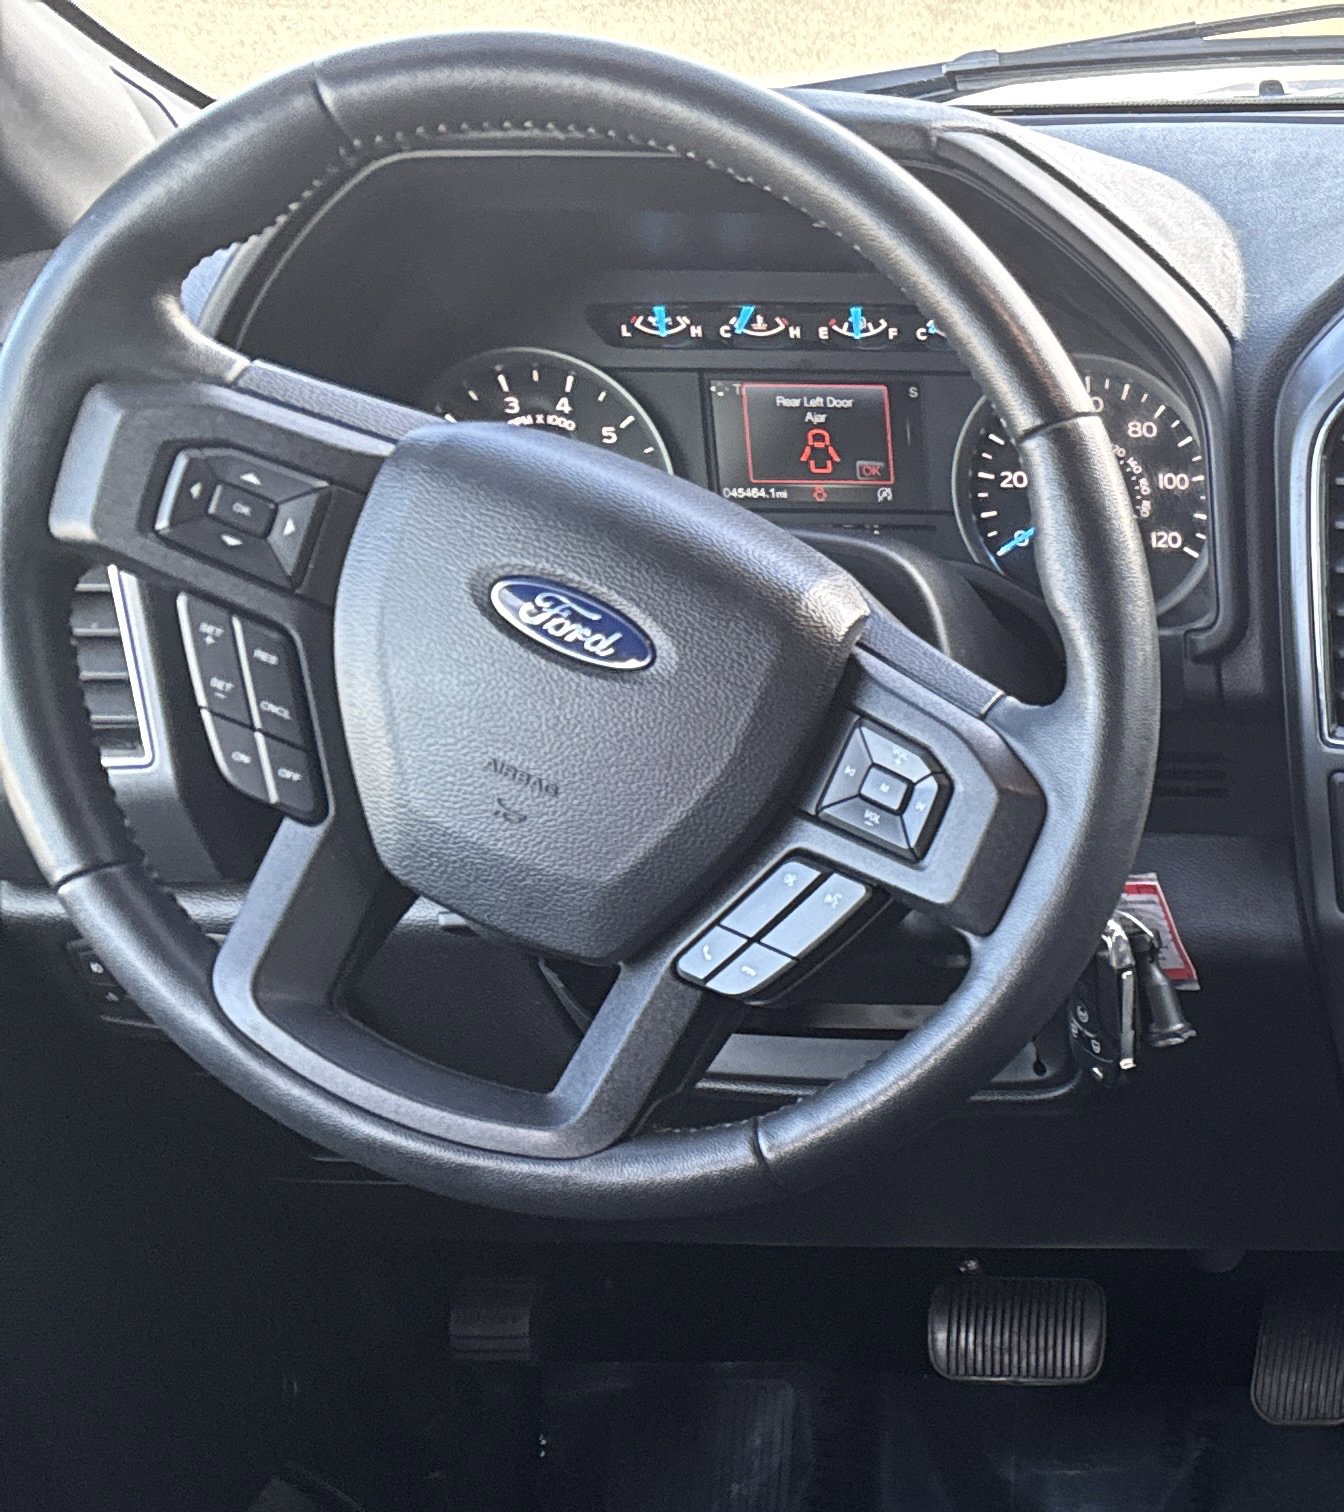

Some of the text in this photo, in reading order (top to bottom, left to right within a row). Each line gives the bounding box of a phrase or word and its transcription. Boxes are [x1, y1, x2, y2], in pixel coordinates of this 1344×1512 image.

[690, 325, 703, 338] H
[719, 325, 802, 339] C H
[818, 326, 899, 340] E F
[915, 325, 929, 341] C
[503, 396, 521, 414] 3
[555, 396, 573, 414] 4
[775, 396, 855, 408] Rear Left Door
[804, 411, 828, 424] Ajar
[601, 425, 618, 444] 5
[1127, 421, 1158, 439] 80
[860, 464, 881, 477] OK
[999, 470, 1029, 489] 20
[1157, 472, 1190, 491] 100
[1150, 531, 1183, 550] 120
[518, 591, 624, 658] Ford
